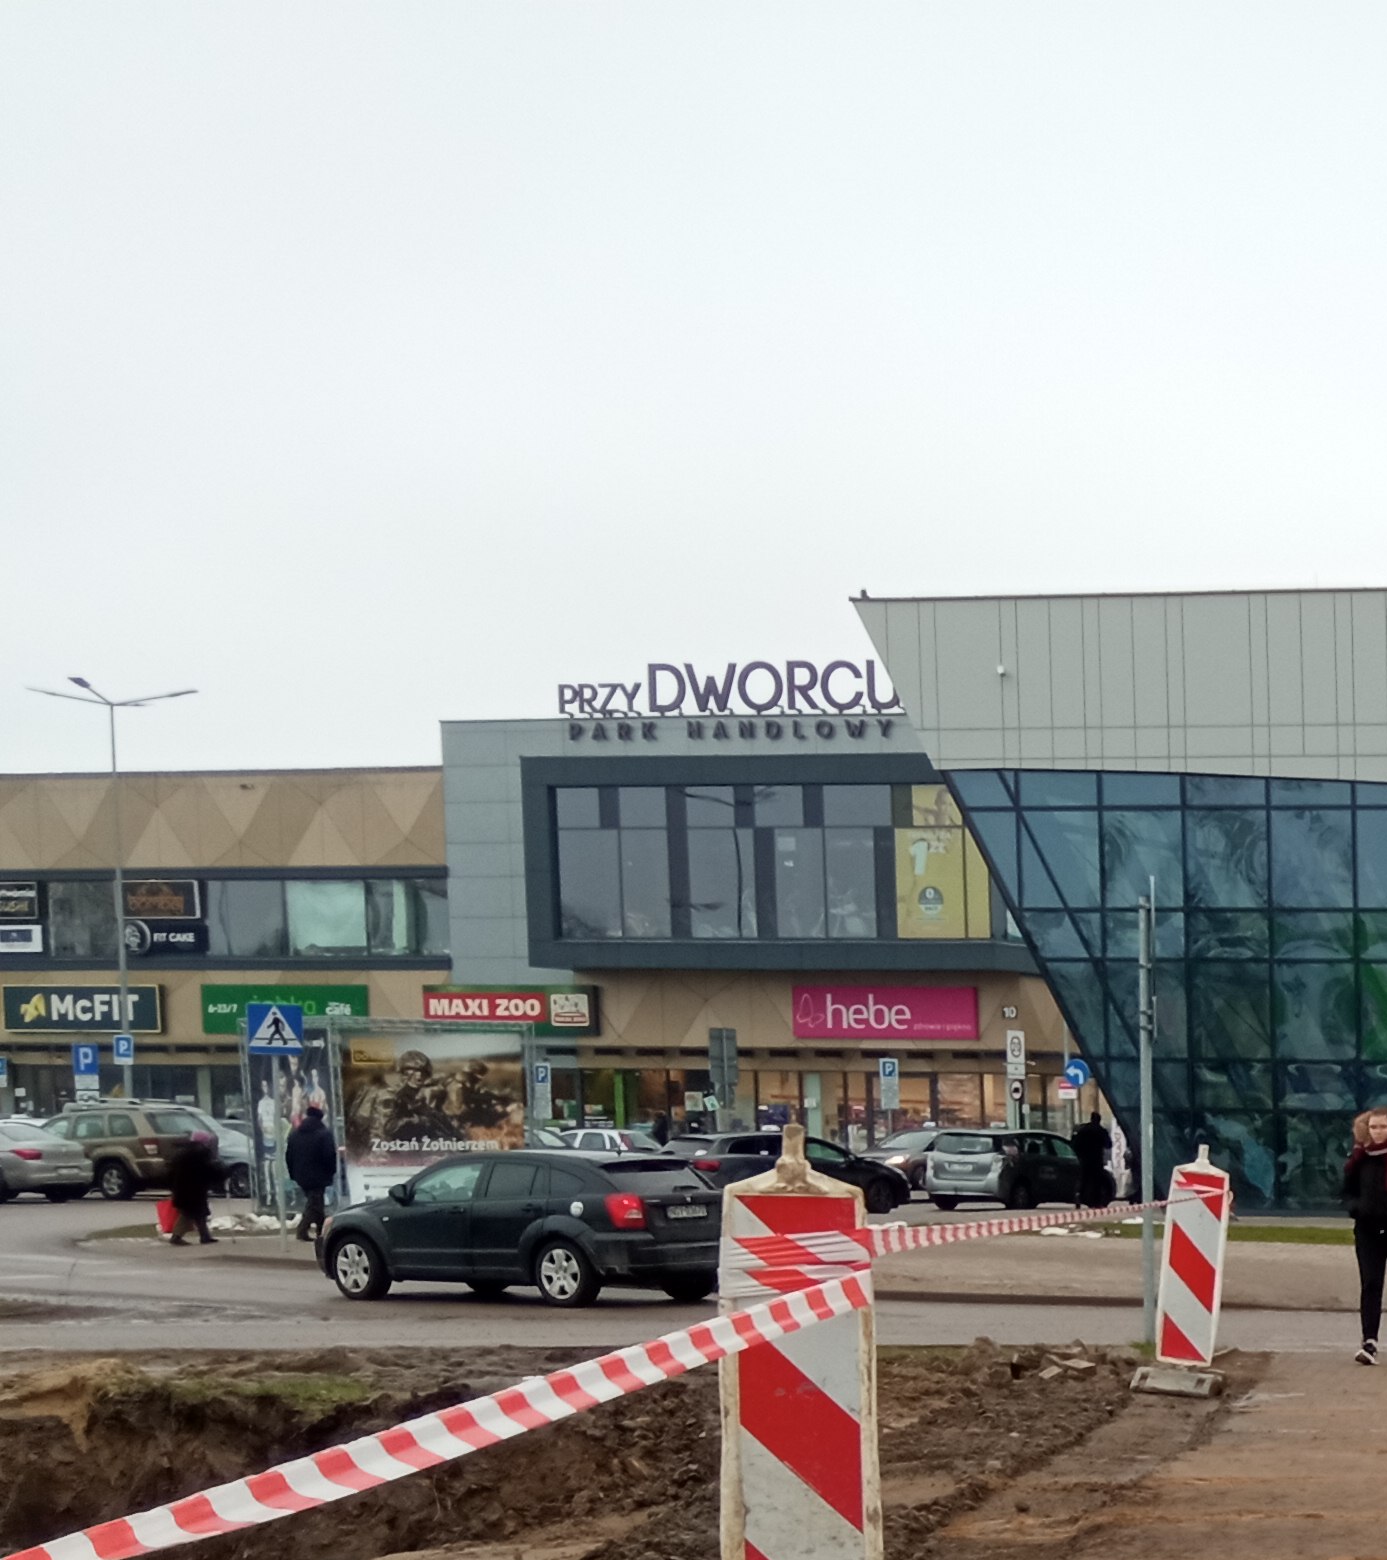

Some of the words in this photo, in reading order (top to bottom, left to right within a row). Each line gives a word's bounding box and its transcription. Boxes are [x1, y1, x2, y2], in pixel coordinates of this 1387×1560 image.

[557, 682, 642, 714] PRZY
[647, 659, 900, 713] DWORCU
[569, 720, 656, 742] PARK
[687, 718, 896, 741] HANDLOWY
[153, 932, 167, 942] FIT
[169, 932, 195, 942] CAKE
[51, 994, 139, 1021] McFIT
[428, 999, 489, 1016] MAXI
[495, 999, 541, 1016] ZOO
[826, 994, 911, 1030] hebe
[1003, 1006, 1017, 1018] 10
[79, 1047, 92, 1071] P
[372, 1138, 418, 1152] Zostań
[421, 1135, 500, 1151] Żołnierzem
